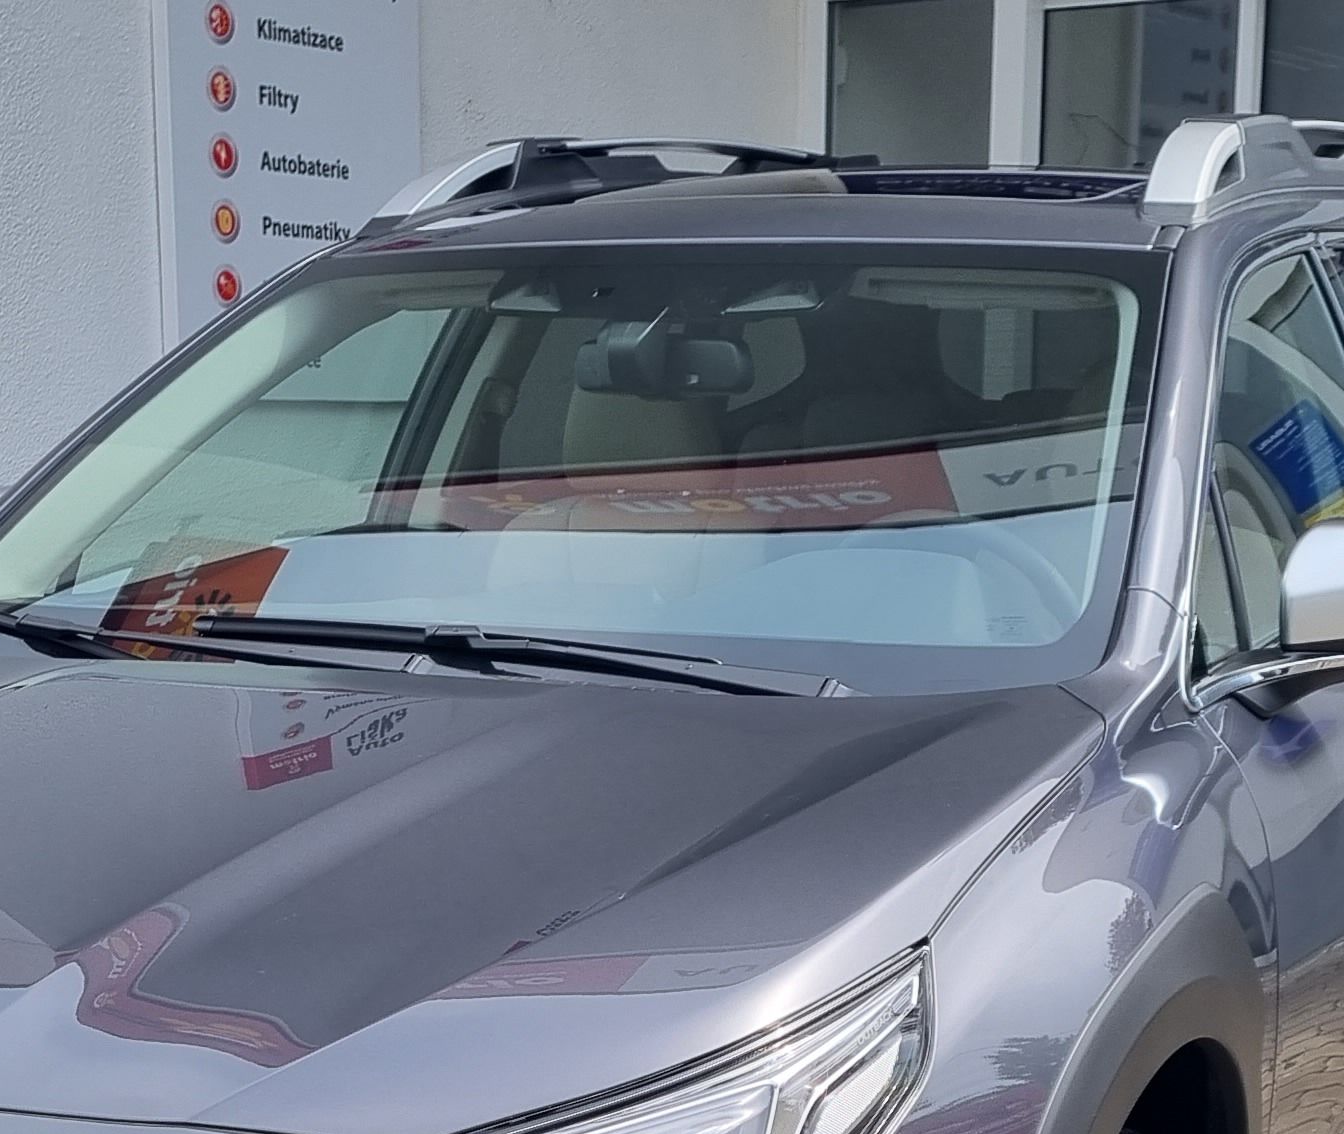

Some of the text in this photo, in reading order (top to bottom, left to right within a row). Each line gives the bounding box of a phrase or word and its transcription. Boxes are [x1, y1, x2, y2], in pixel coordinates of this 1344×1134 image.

[257, 17, 344, 52] Klimatizace
[258, 84, 299, 114] Filtry
[261, 151, 349, 180] Autobaterie
[262, 216, 351, 243] Pneumatiky
